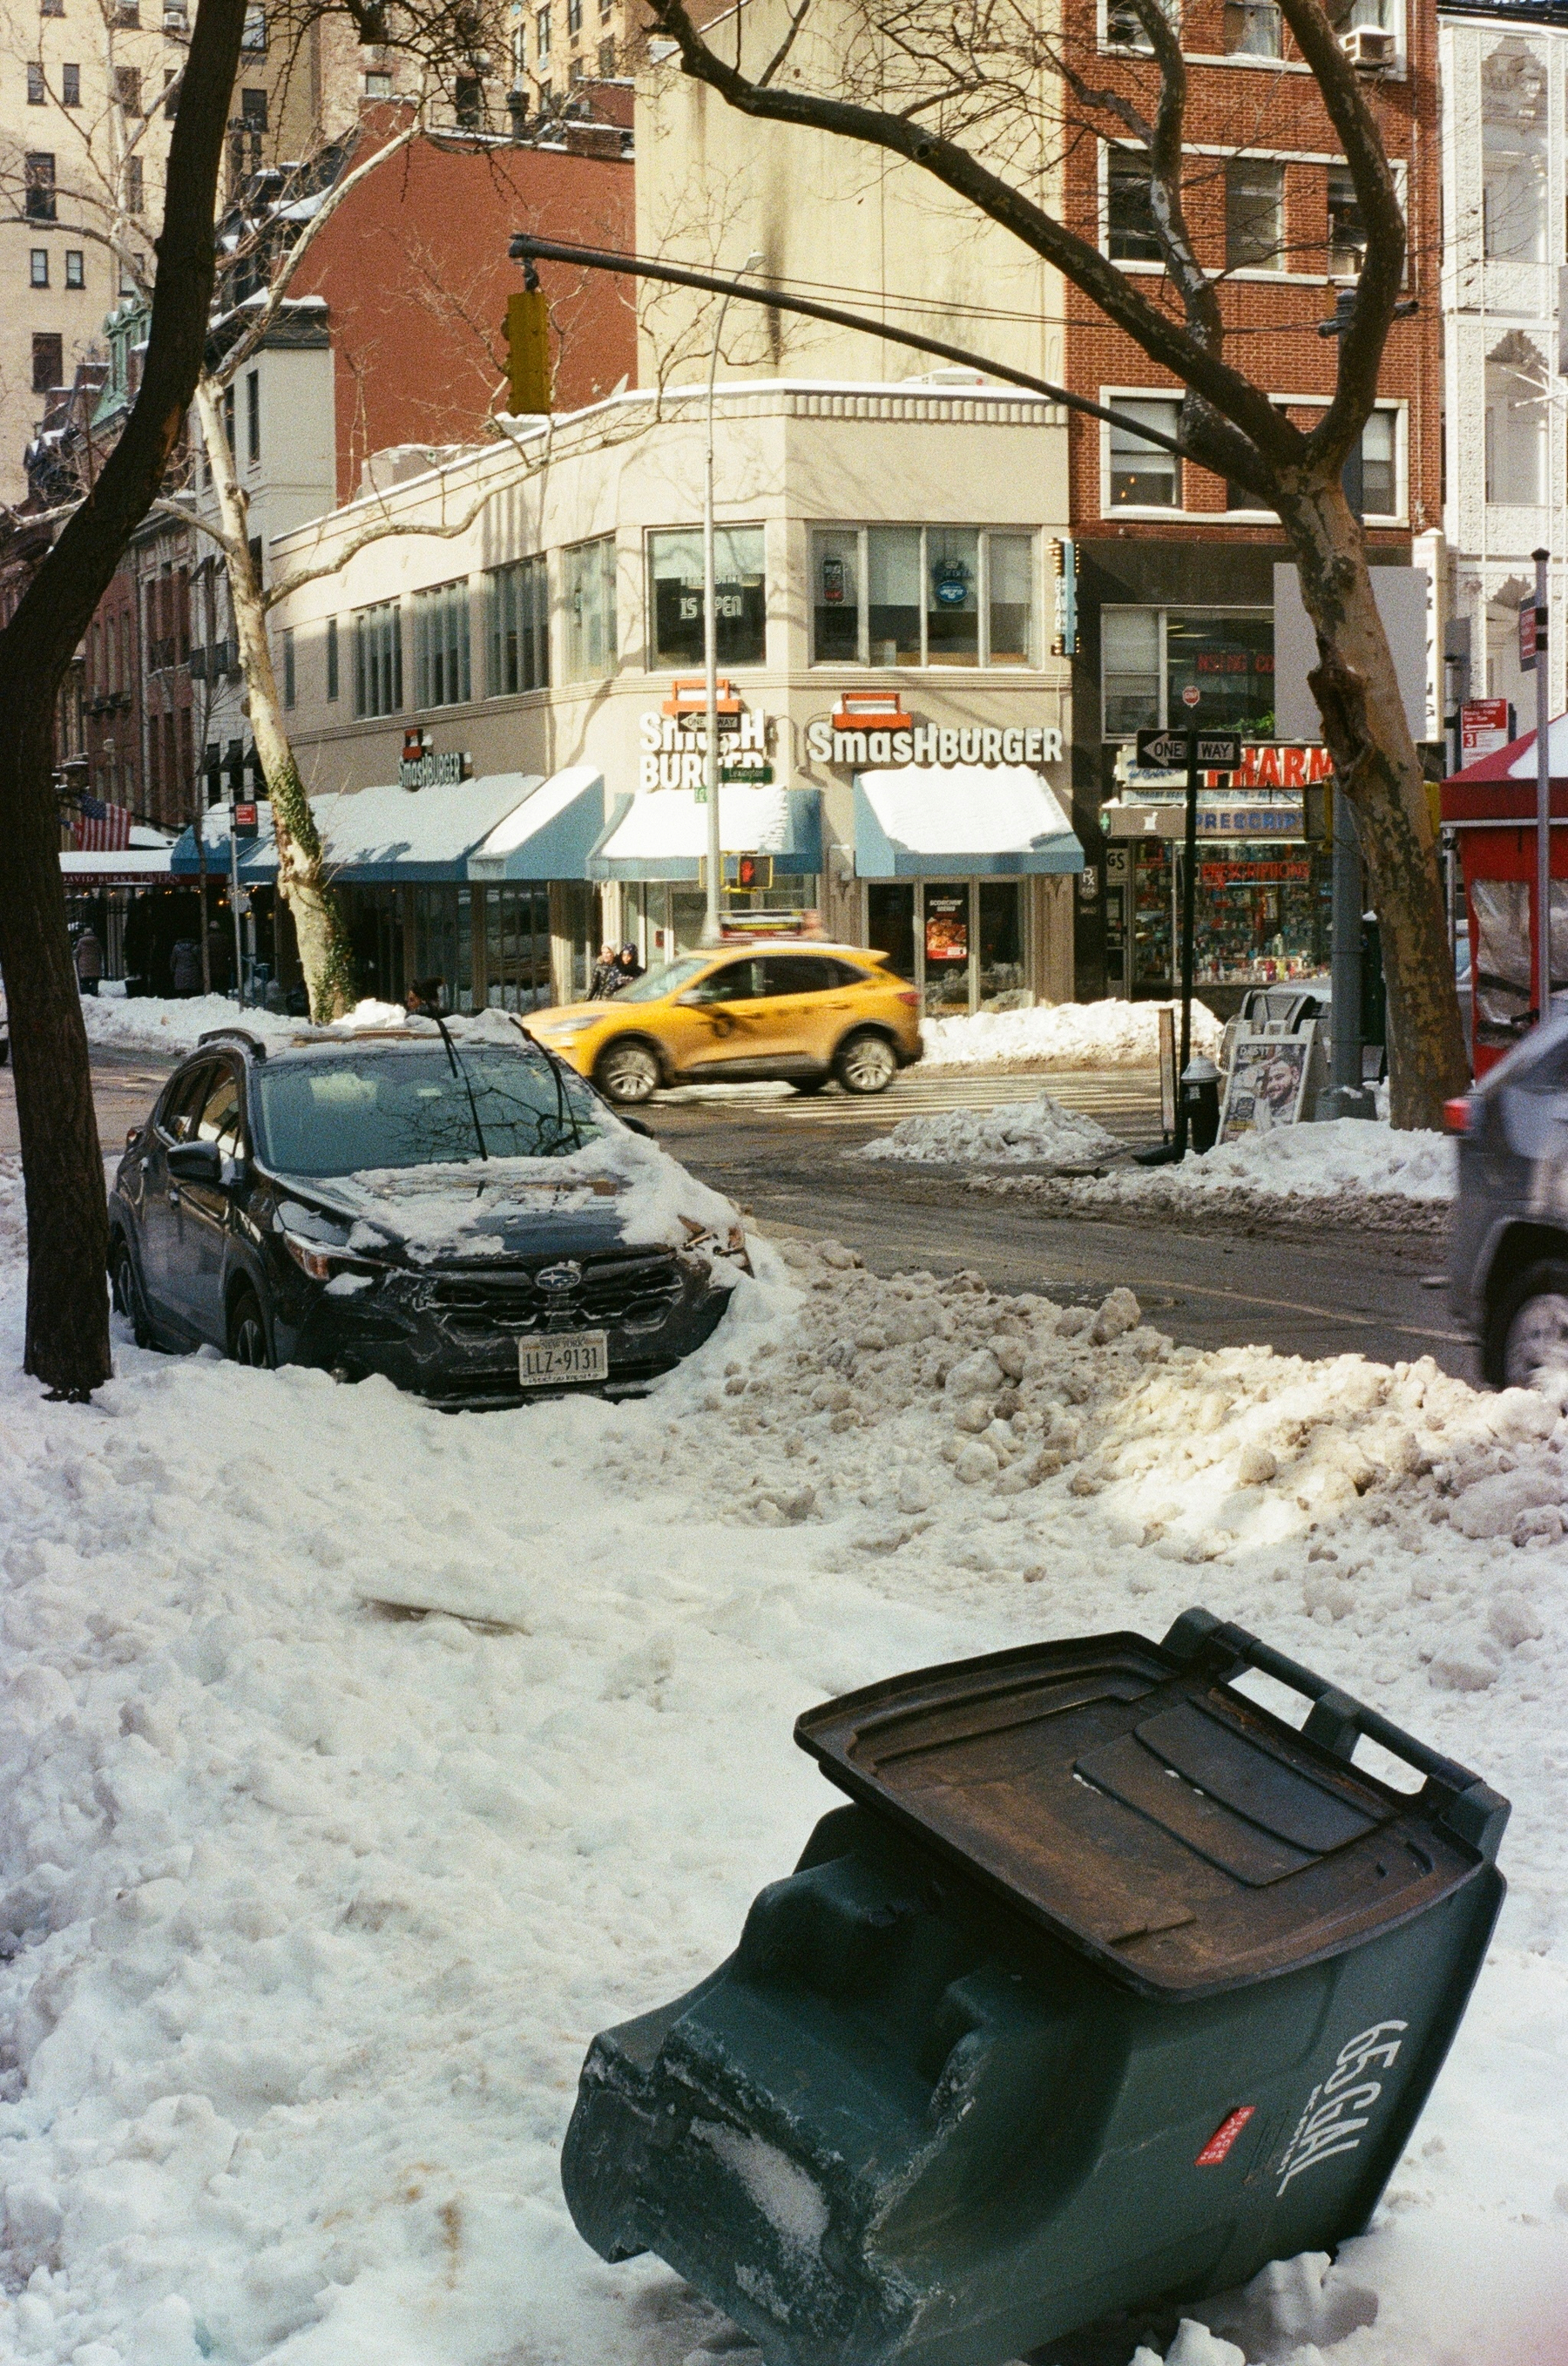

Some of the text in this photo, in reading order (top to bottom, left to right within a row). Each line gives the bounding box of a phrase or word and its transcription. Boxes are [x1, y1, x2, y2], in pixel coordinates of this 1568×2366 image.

[703, 595, 741, 619] PEN
[1154, 742, 1230, 758] ONE WAY
[1466, 733, 1474, 747] 3
[139, 873, 179, 883] TAVERN
[1324, 2019, 1409, 2094] 65
[1276, 2081, 1382, 2197] GAL
